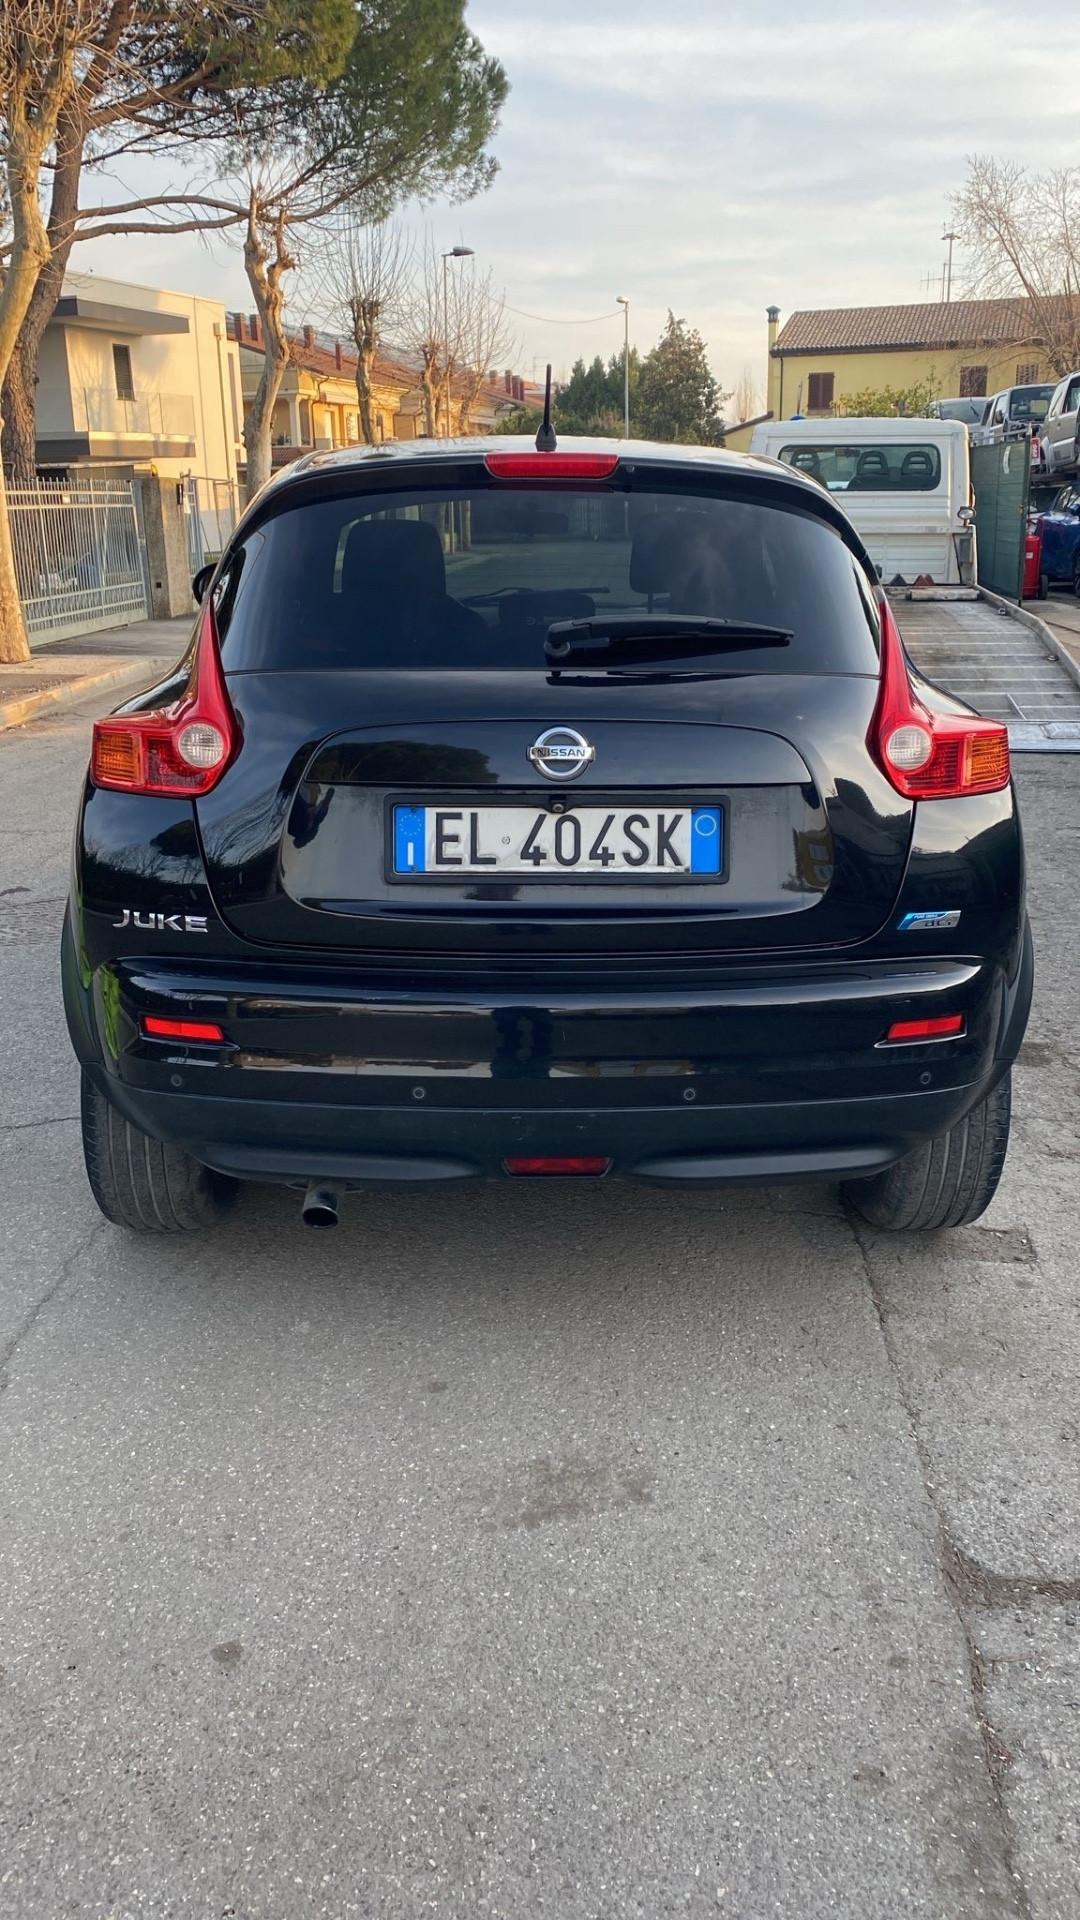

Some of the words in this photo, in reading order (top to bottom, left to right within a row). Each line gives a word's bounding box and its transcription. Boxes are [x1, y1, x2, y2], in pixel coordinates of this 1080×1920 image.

[536, 748, 585, 757] NISSAN
[435, 812, 497, 866] EL
[520, 814, 684, 867] 404SK
[112, 909, 208, 933] JUKE
